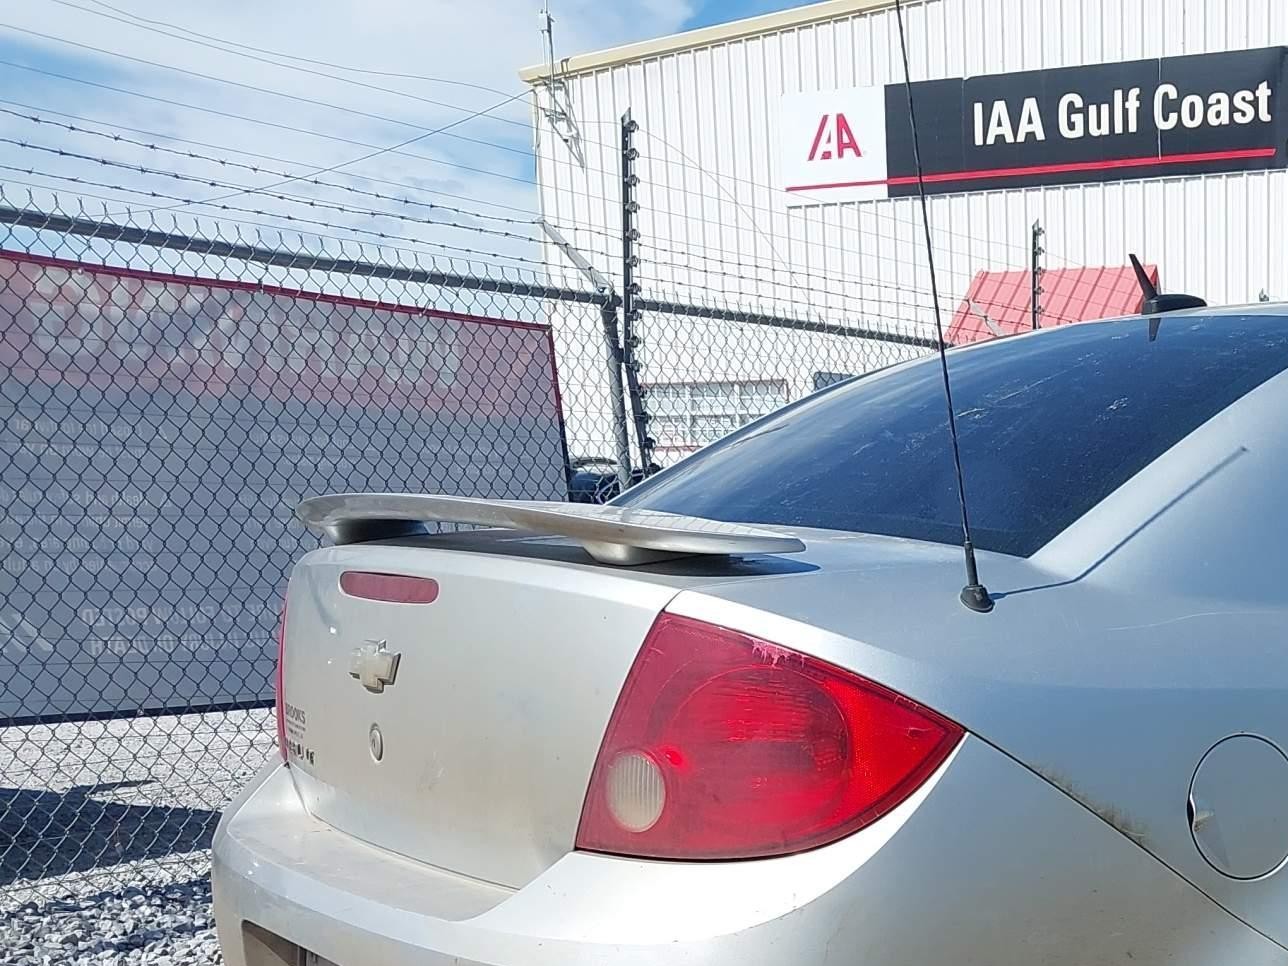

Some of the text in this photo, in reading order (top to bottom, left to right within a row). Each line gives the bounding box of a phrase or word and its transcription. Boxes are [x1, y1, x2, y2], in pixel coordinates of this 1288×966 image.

[974, 80, 1272, 146] IAA Gulf Coast
